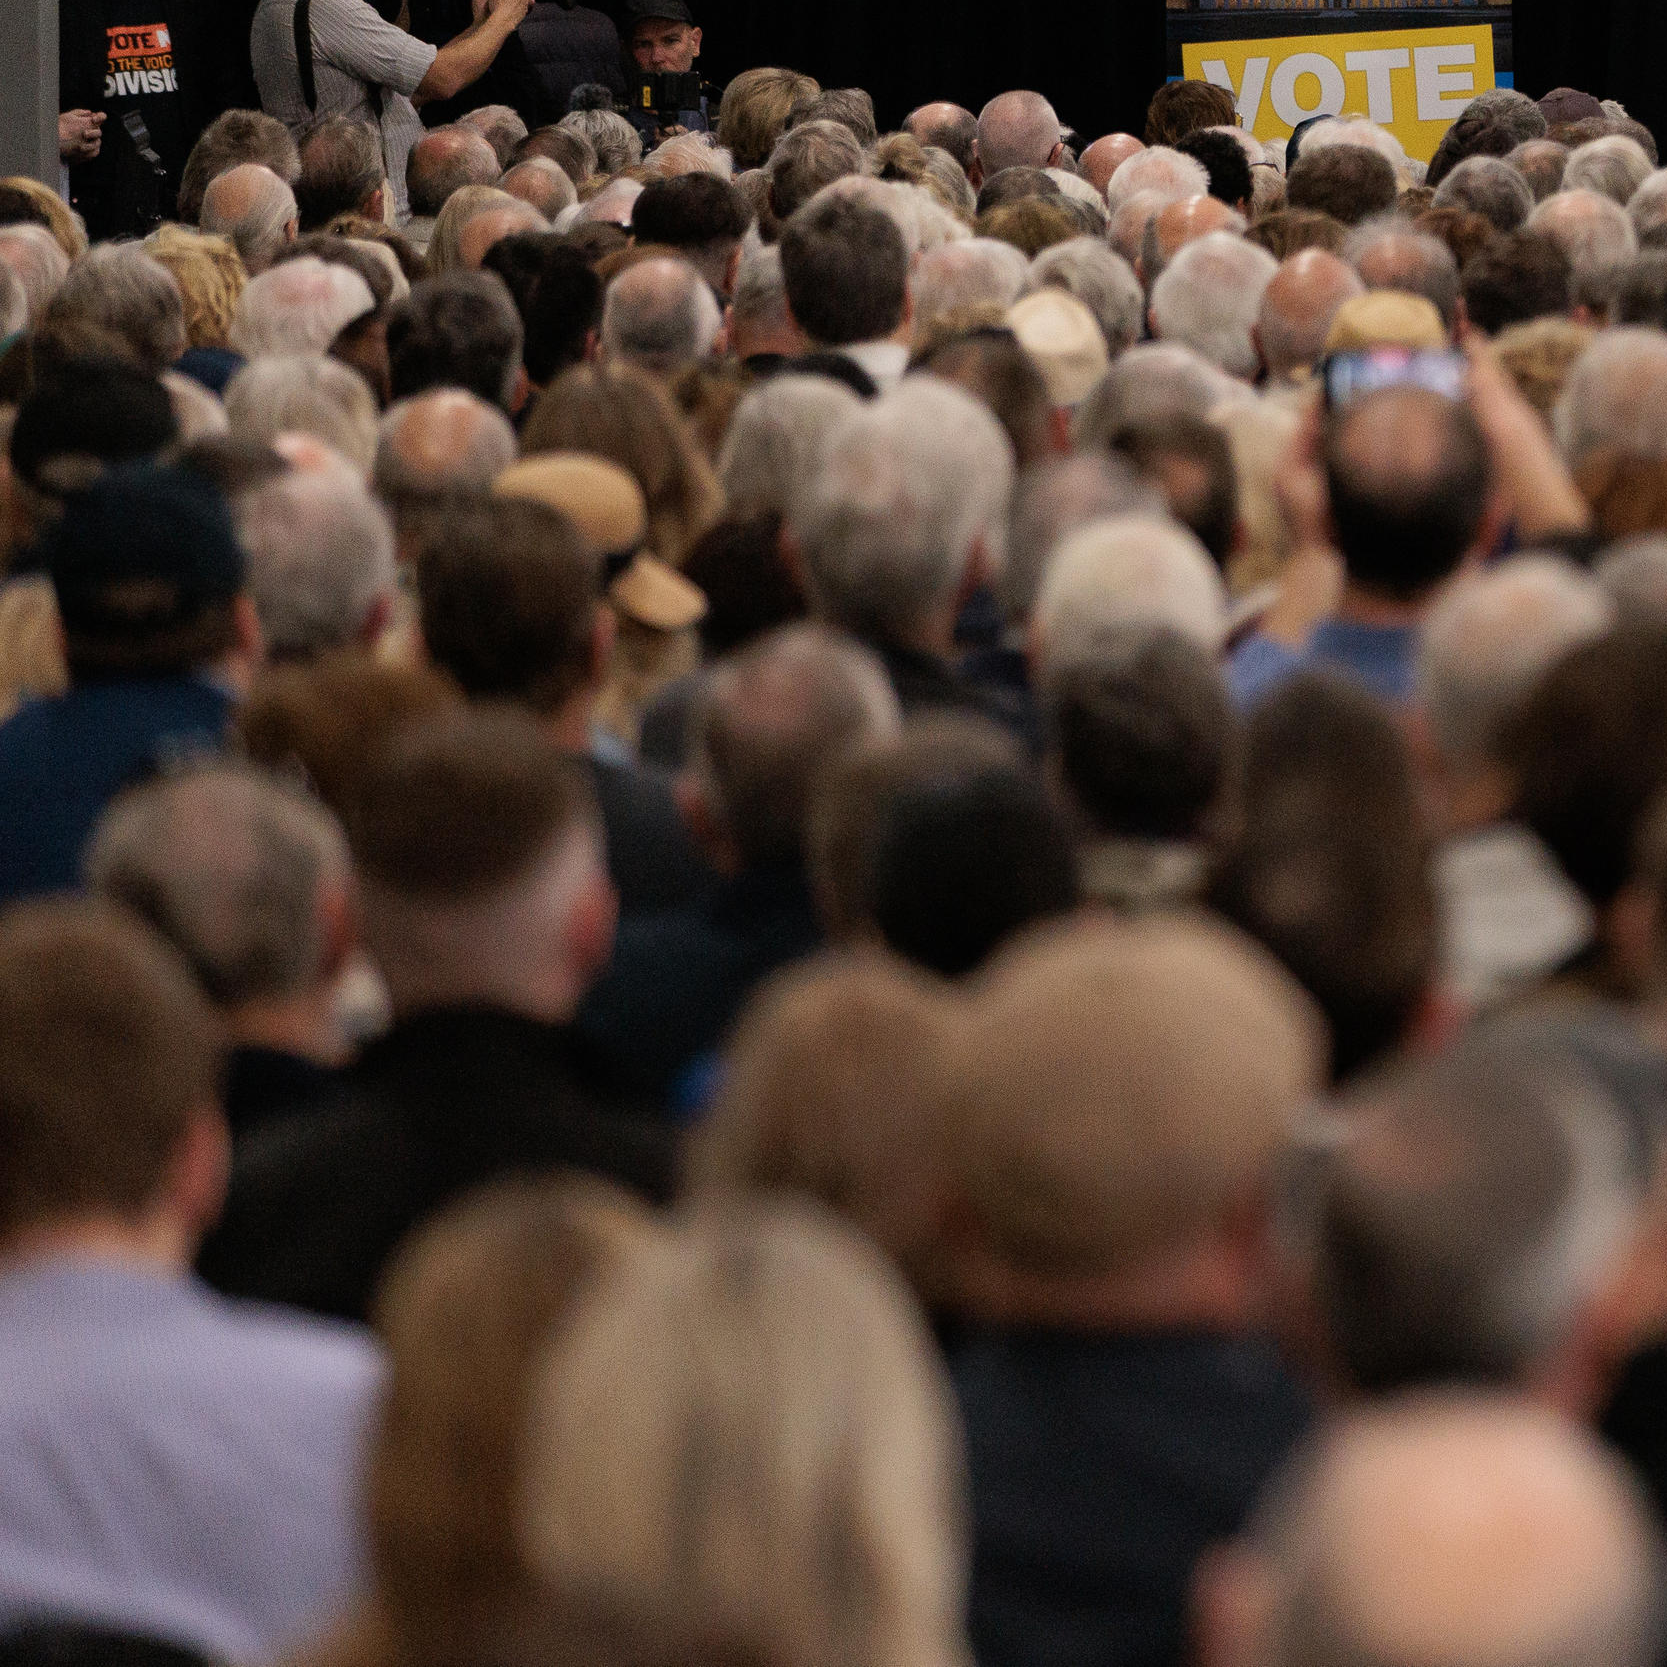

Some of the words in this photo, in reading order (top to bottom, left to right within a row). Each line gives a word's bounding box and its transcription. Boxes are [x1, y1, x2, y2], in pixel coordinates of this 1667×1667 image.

[116, 57, 143, 71] THE
[104, 68, 179, 98] DIVISI
[1201, 44, 1477, 132] VOTE
